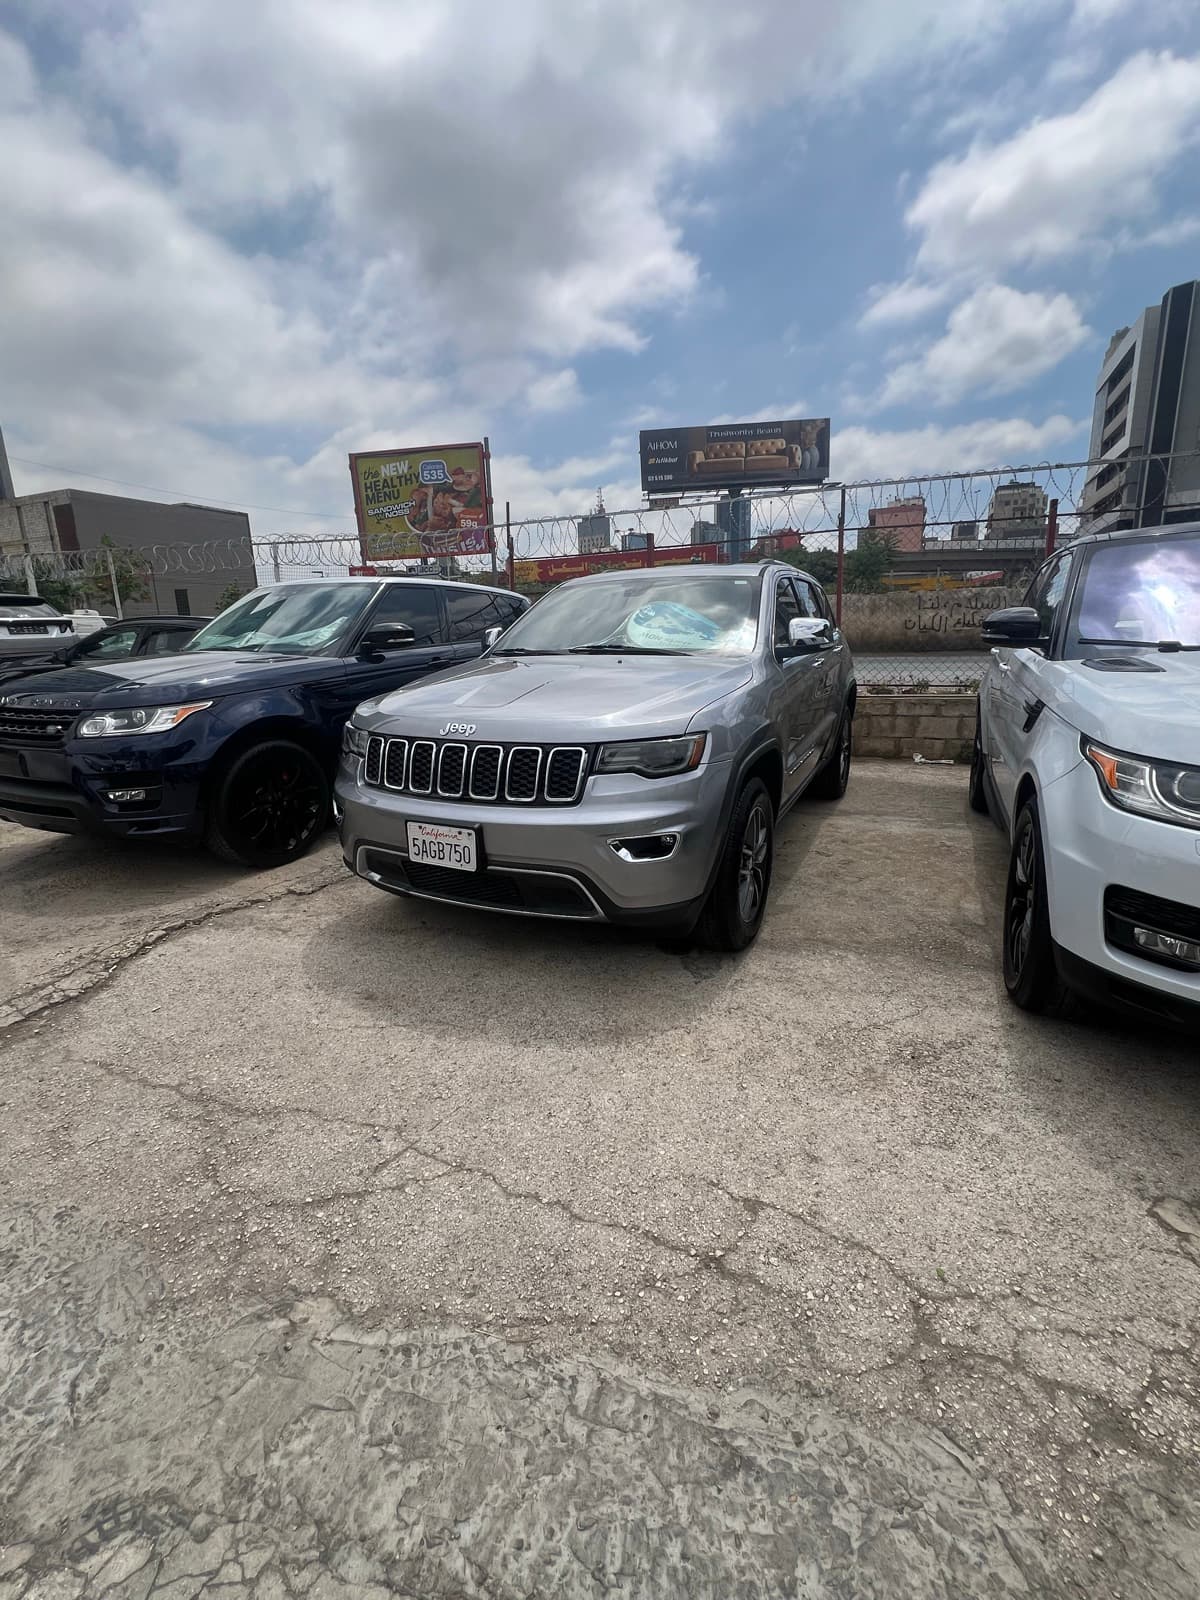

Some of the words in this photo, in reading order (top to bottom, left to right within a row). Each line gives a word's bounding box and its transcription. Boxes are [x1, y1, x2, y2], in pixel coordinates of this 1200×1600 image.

[363, 465, 380, 480] the
[381, 460, 408, 477] NEW
[423, 470, 444, 480] 535
[364, 471, 420, 492] HEALTHY
[365, 488, 400, 505] MENU
[367, 499, 416, 516] SANDWICH
[439, 722, 477, 738] Jeep
[421, 826, 464, 841] California
[412, 837, 471, 864] 5AGB750
